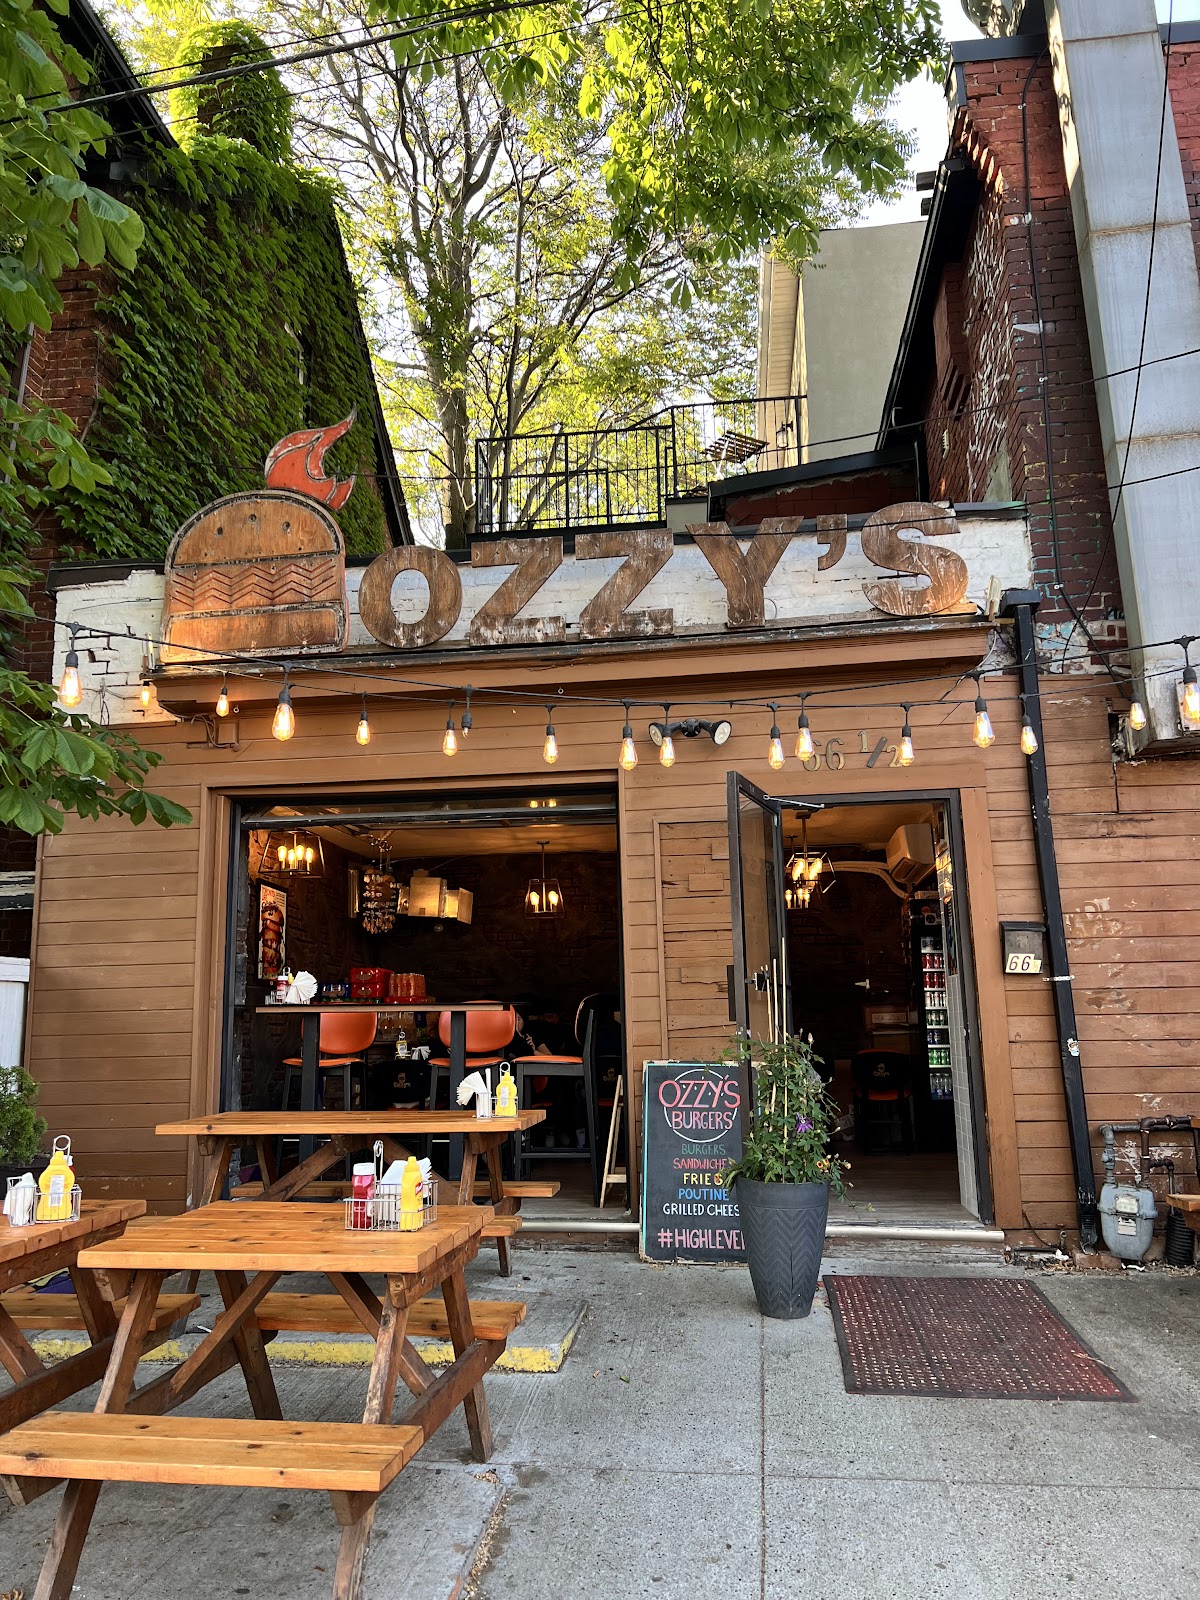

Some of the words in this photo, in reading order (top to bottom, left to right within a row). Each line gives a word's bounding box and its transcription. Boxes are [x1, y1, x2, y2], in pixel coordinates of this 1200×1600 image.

[358, 501, 968, 649] OZZY'S
[1009, 955, 1031, 971] 66
[658, 1074, 741, 1109] OZZY'S
[672, 1111, 733, 1130] BURGERS
[681, 1143, 726, 1156] BURGERS
[673, 1157, 728, 1170] SANDWICHE
[678, 1188, 730, 1201] POUTINE
[663, 1203, 705, 1216] GRILLED
[707, 1203, 740, 1217] CHEES
